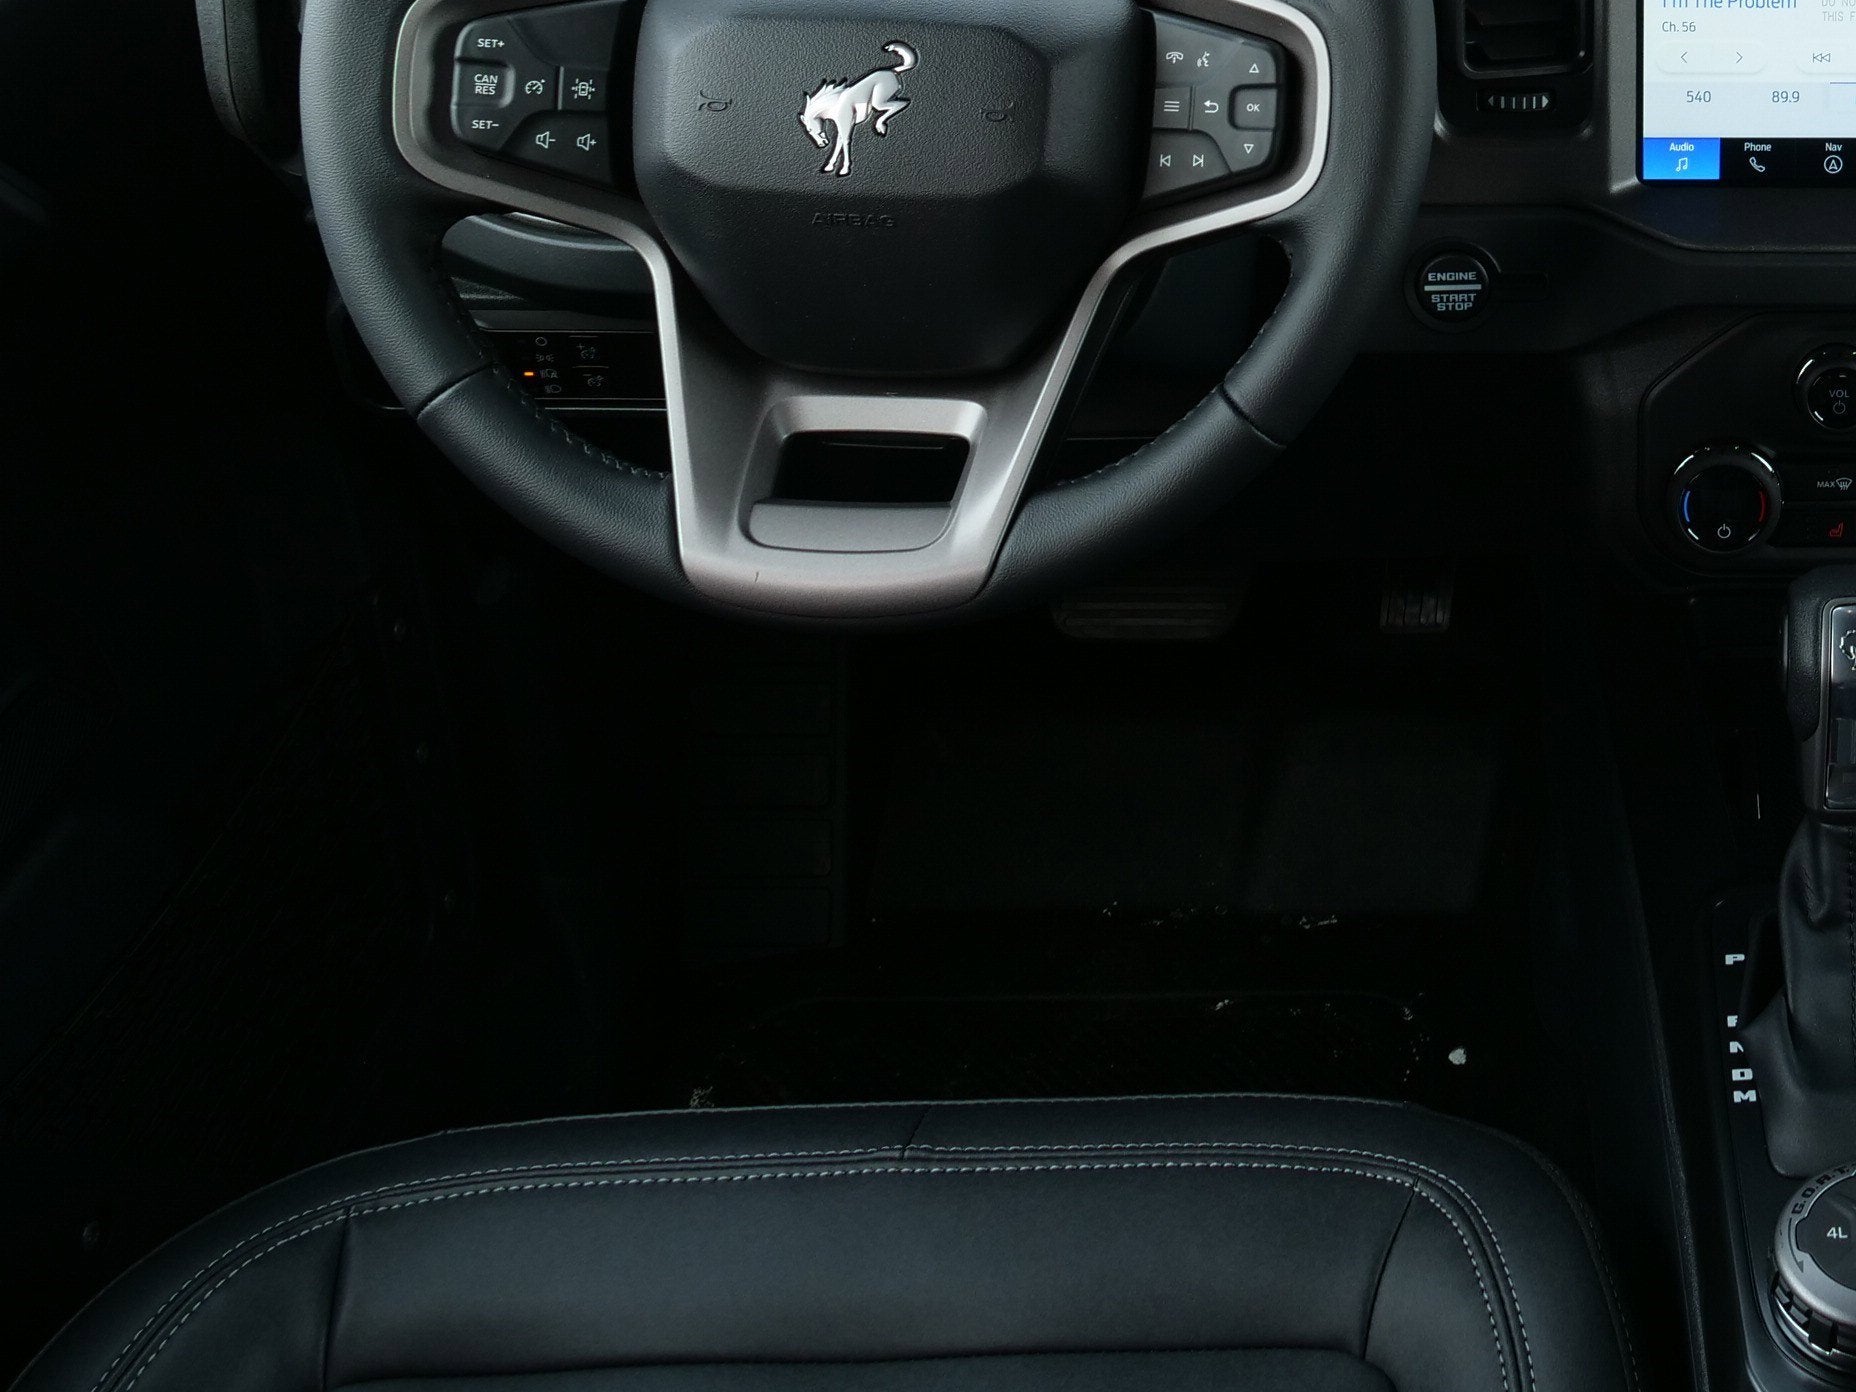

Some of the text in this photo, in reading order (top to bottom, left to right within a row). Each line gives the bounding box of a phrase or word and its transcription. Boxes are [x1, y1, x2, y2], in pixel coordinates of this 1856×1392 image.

[1822, 10, 1844, 22] THIS
[1661, 21, 1696, 33] Ch. 56
[476, 38, 505, 48] SET+
[474, 73, 498, 83] CAN
[474, 85, 496, 95] RES
[1686, 90, 1712, 103] 540
[1771, 90, 1800, 103] 89.9
[1246, 103, 1260, 113] OK
[1669, 142, 1695, 152] Audio
[1744, 142, 1772, 152] Phone
[1824, 142, 1843, 152] Nav
[1427, 271, 1478, 282] ENGINE
[1430, 293, 1477, 303] START
[1436, 301, 1473, 311] STOP
[1828, 389, 1850, 398] VOL
[1816, 480, 1836, 489] MAX
[1724, 953, 1746, 965] P
[1731, 1068, 1754, 1082] D
[1733, 1089, 1757, 1103] M
[1826, 1226, 1848, 1239] 4L
